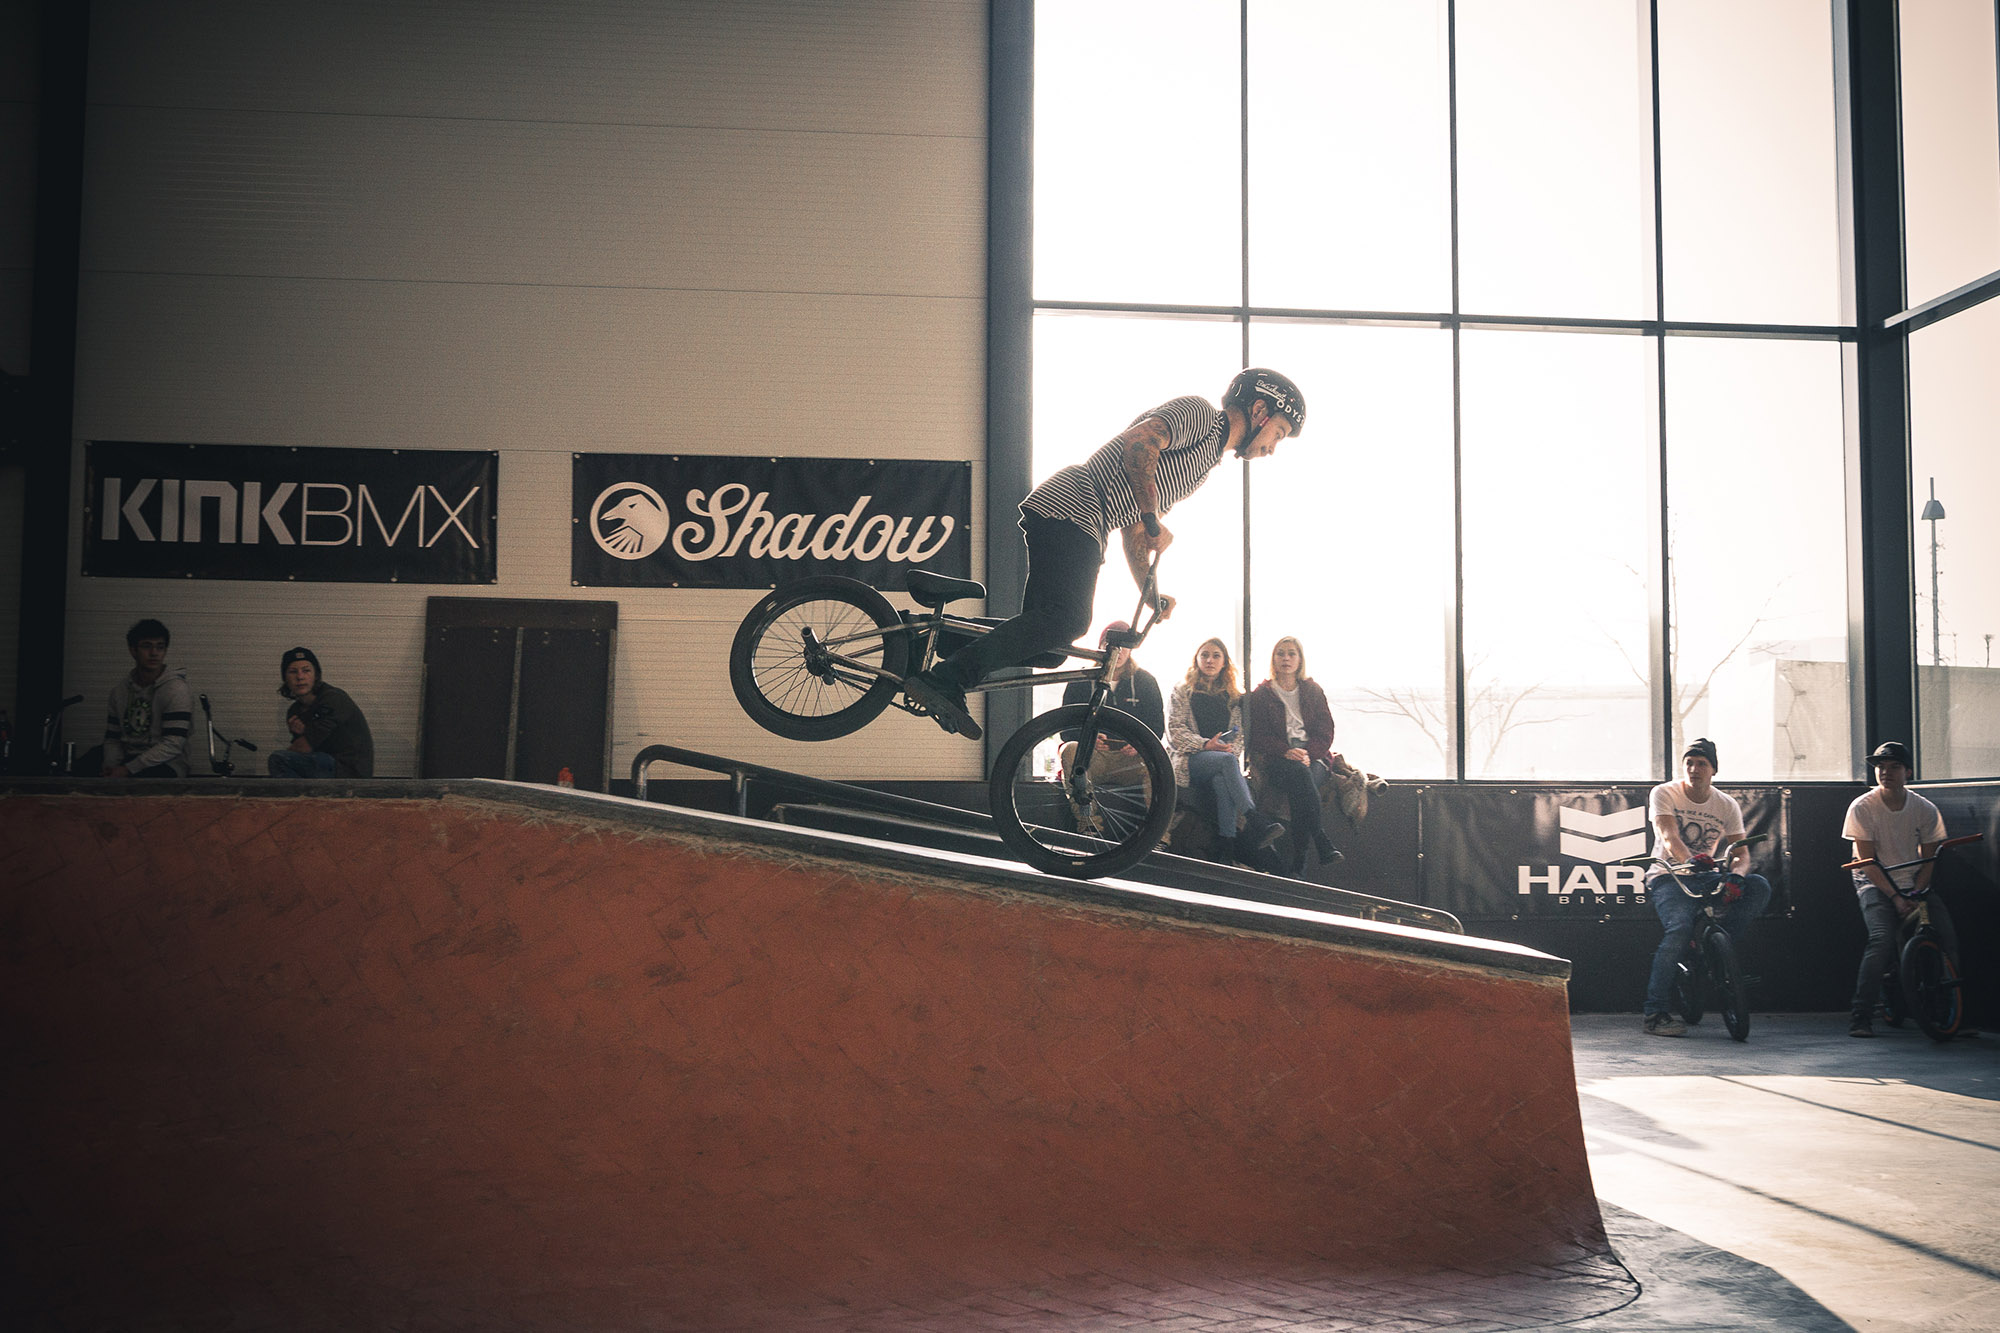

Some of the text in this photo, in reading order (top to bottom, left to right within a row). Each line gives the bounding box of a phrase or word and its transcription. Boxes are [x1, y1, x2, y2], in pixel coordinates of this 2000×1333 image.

[672, 482, 955, 562] Shadow
[1518, 865, 1646, 894] HAR
[1559, 895, 1646, 904] BIKES
